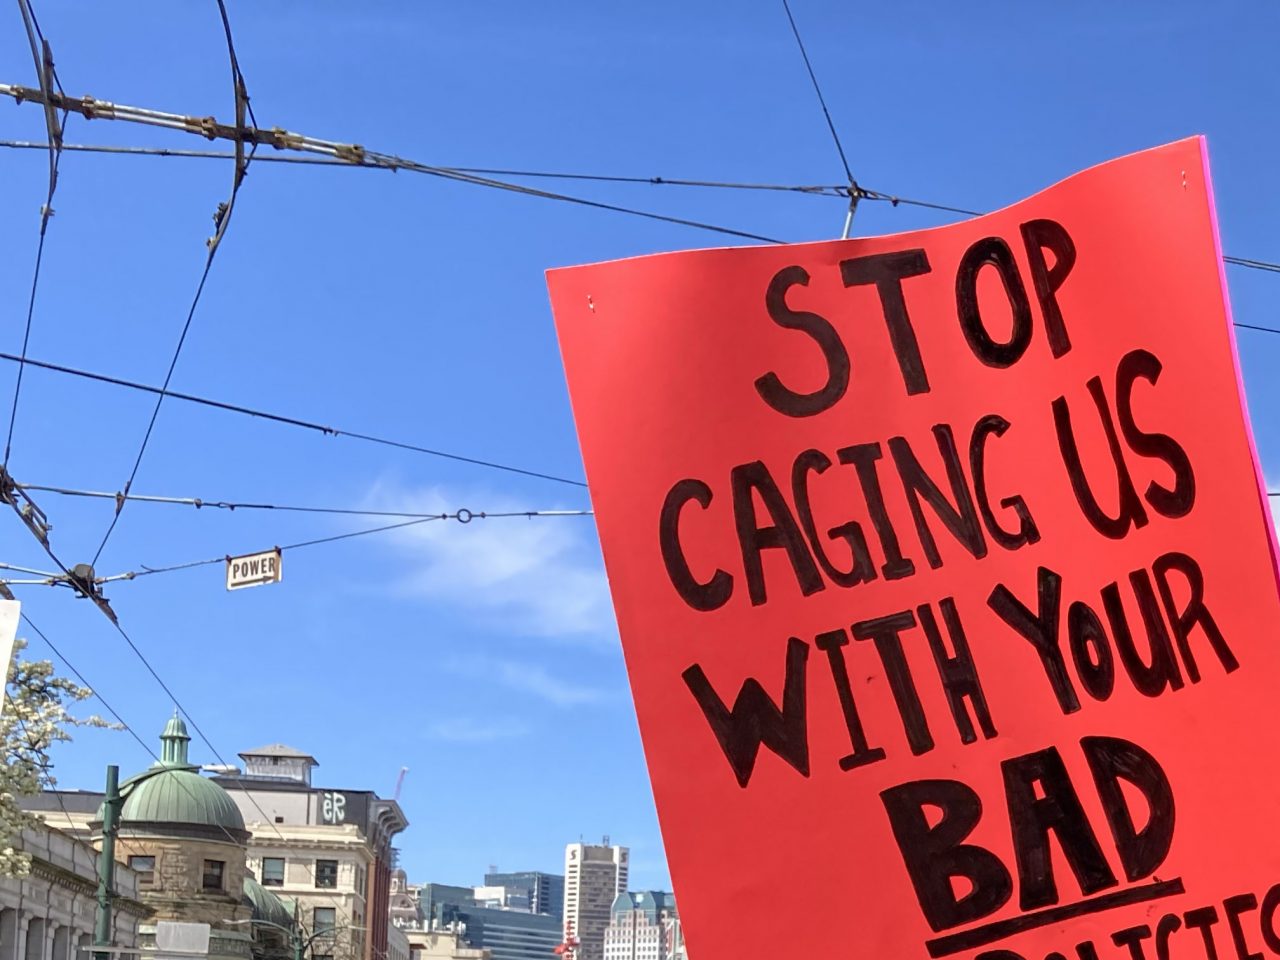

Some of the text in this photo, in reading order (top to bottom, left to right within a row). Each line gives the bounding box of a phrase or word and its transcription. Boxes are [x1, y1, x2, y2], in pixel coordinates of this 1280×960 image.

[755, 218, 1077, 418] STOP
[232, 557, 276, 580] POWER
[658, 348, 1196, 611] CAGING US
[681, 551, 1241, 788] WITH YOUR
[880, 735, 1176, 934] BAD
